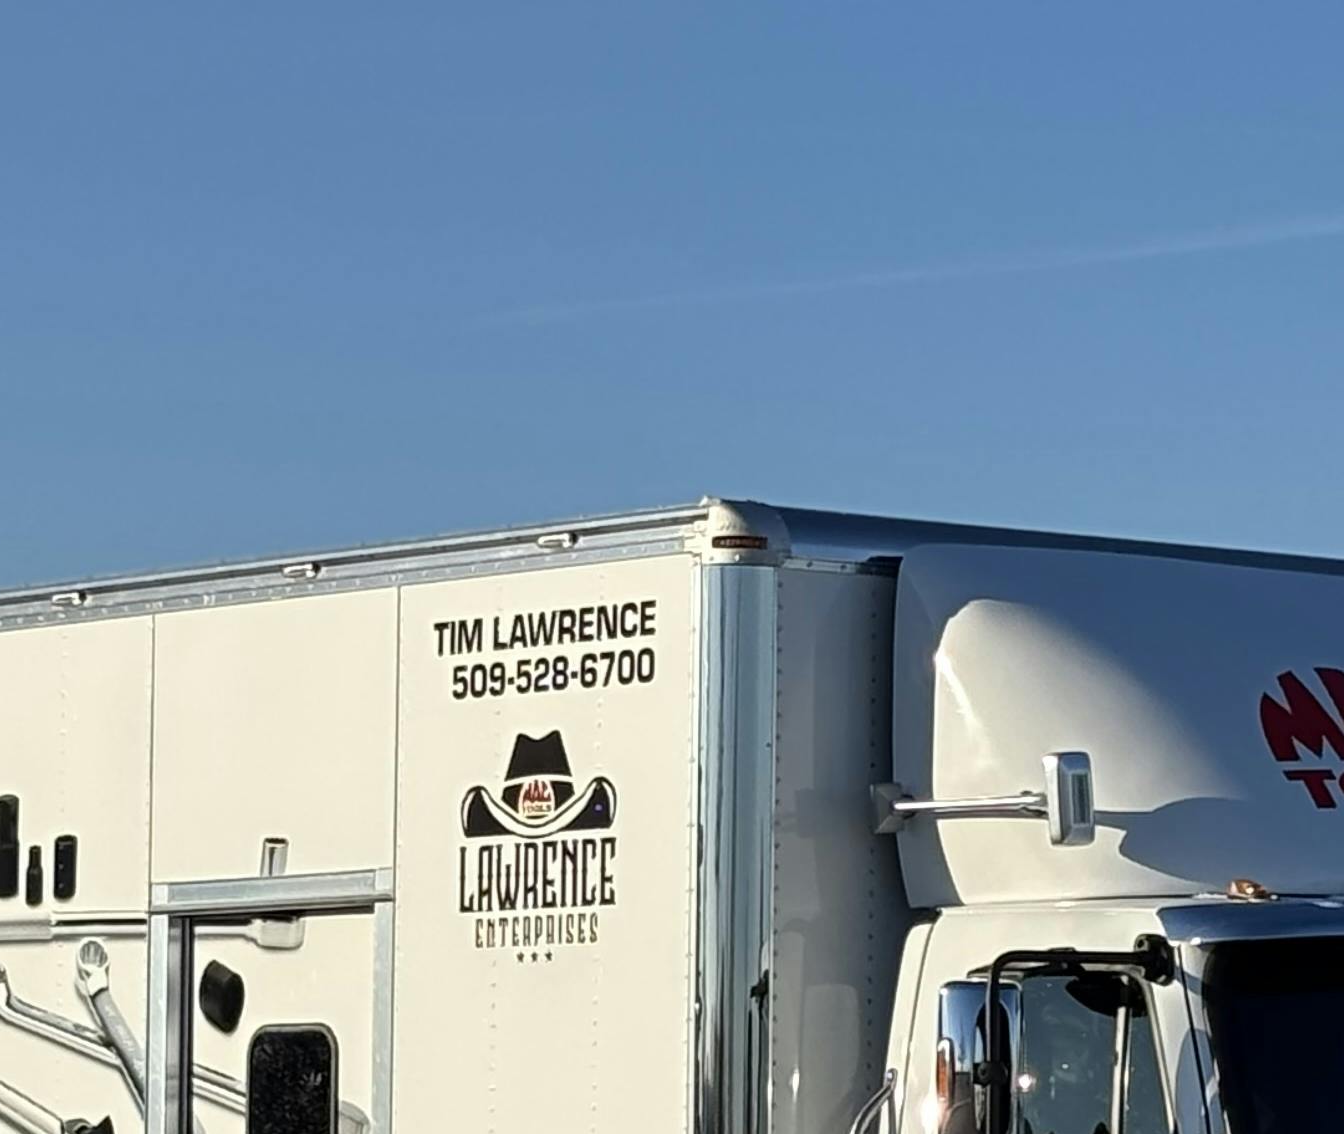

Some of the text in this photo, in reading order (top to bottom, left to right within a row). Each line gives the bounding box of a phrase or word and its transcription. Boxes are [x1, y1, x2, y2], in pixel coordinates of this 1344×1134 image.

[434, 600, 656, 656] TIM LAWRENCE
[452, 648, 656, 700] 509-528-6700
[459, 838, 616, 914] LAWRENCE
[475, 914, 599, 948] ENTERPRISES
